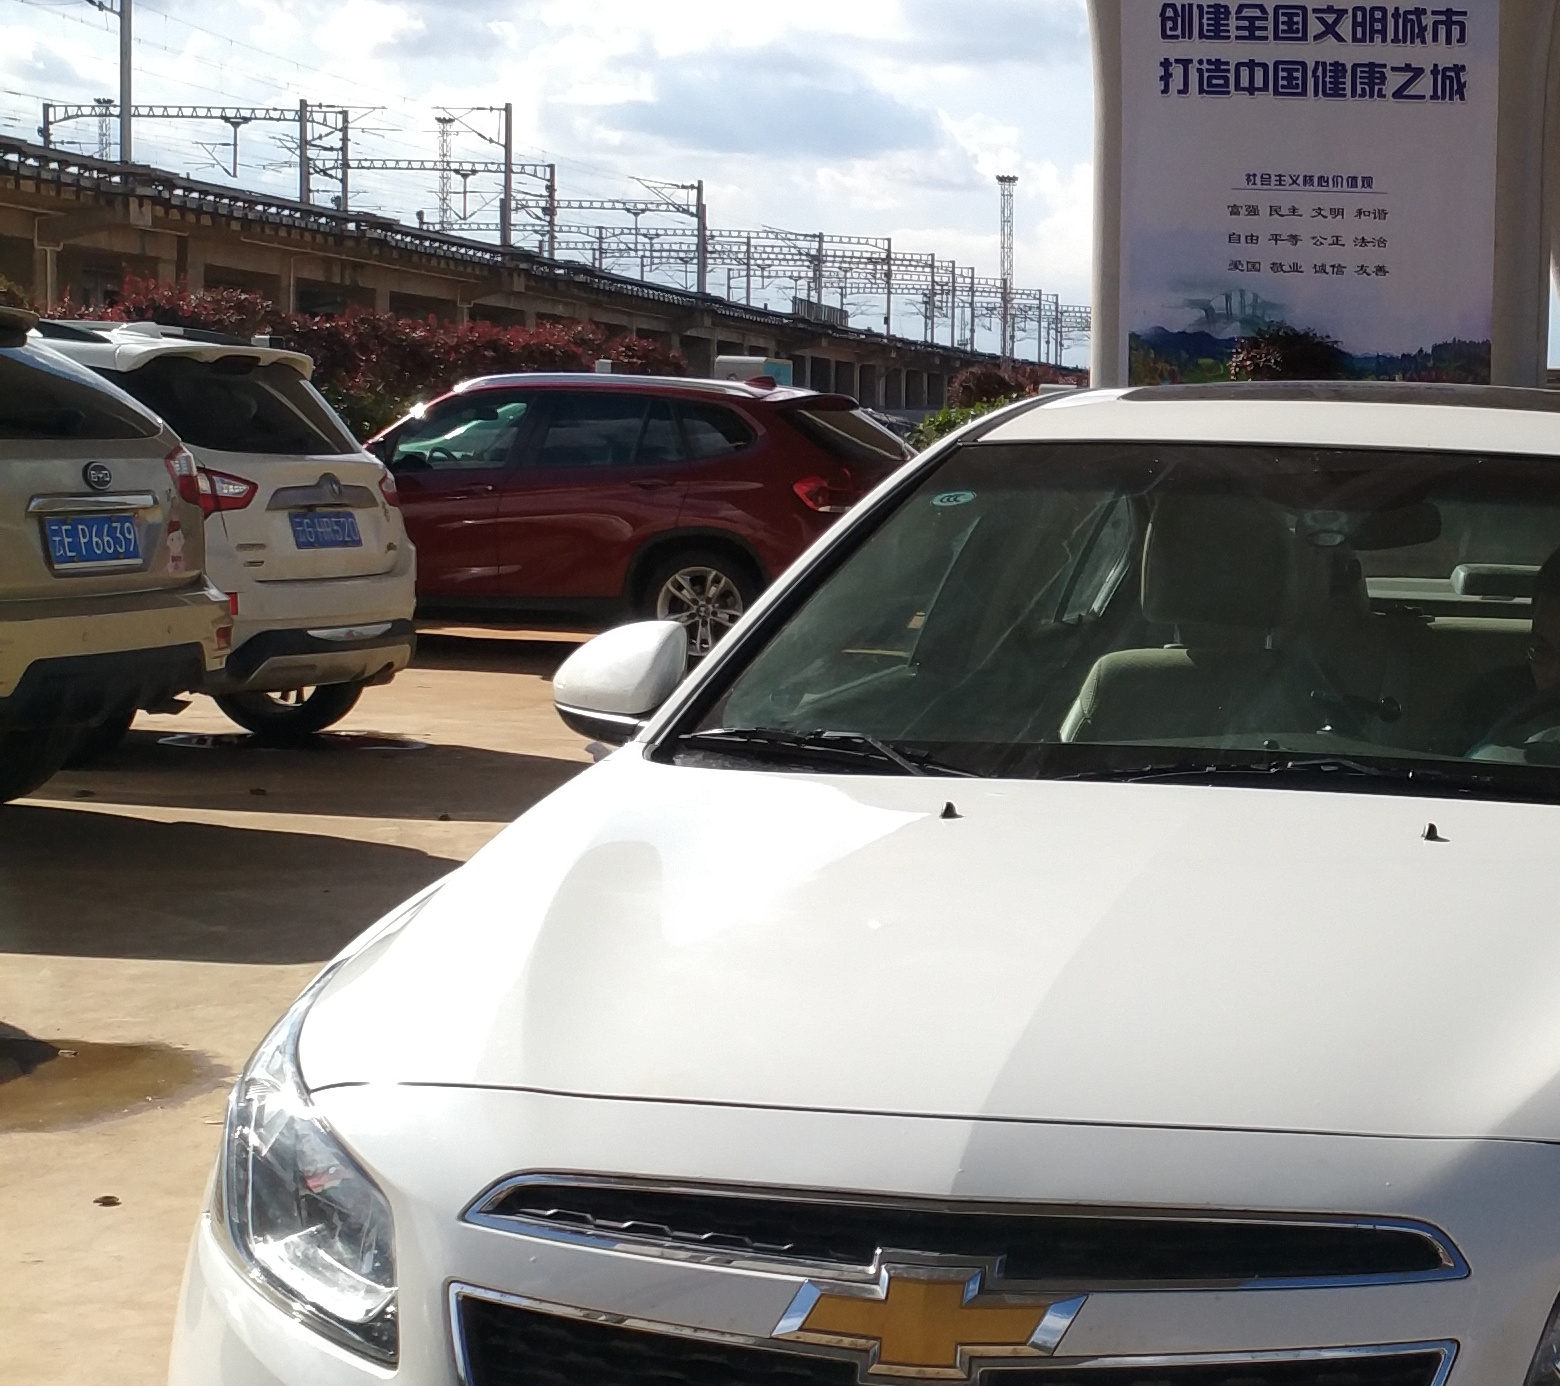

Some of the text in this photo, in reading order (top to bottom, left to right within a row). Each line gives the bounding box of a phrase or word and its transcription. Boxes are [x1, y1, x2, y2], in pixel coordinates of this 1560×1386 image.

[1159, 2, 1468, 46] 创建全国文明城市
[1159, 57, 1468, 102] 打造中国健康之城
[1245, 172, 1374, 190] 社会主义核心价值观
[1227, 204, 1388, 221] 富强 民主 文明 和谐
[1228, 232, 1388, 248] 自由 平等 公正 法治
[1227, 259, 1389, 276] 爱国 敬业 诚信 友善
[90, 470, 110, 482] BYD
[50, 522, 135, 557] 云EP6639
